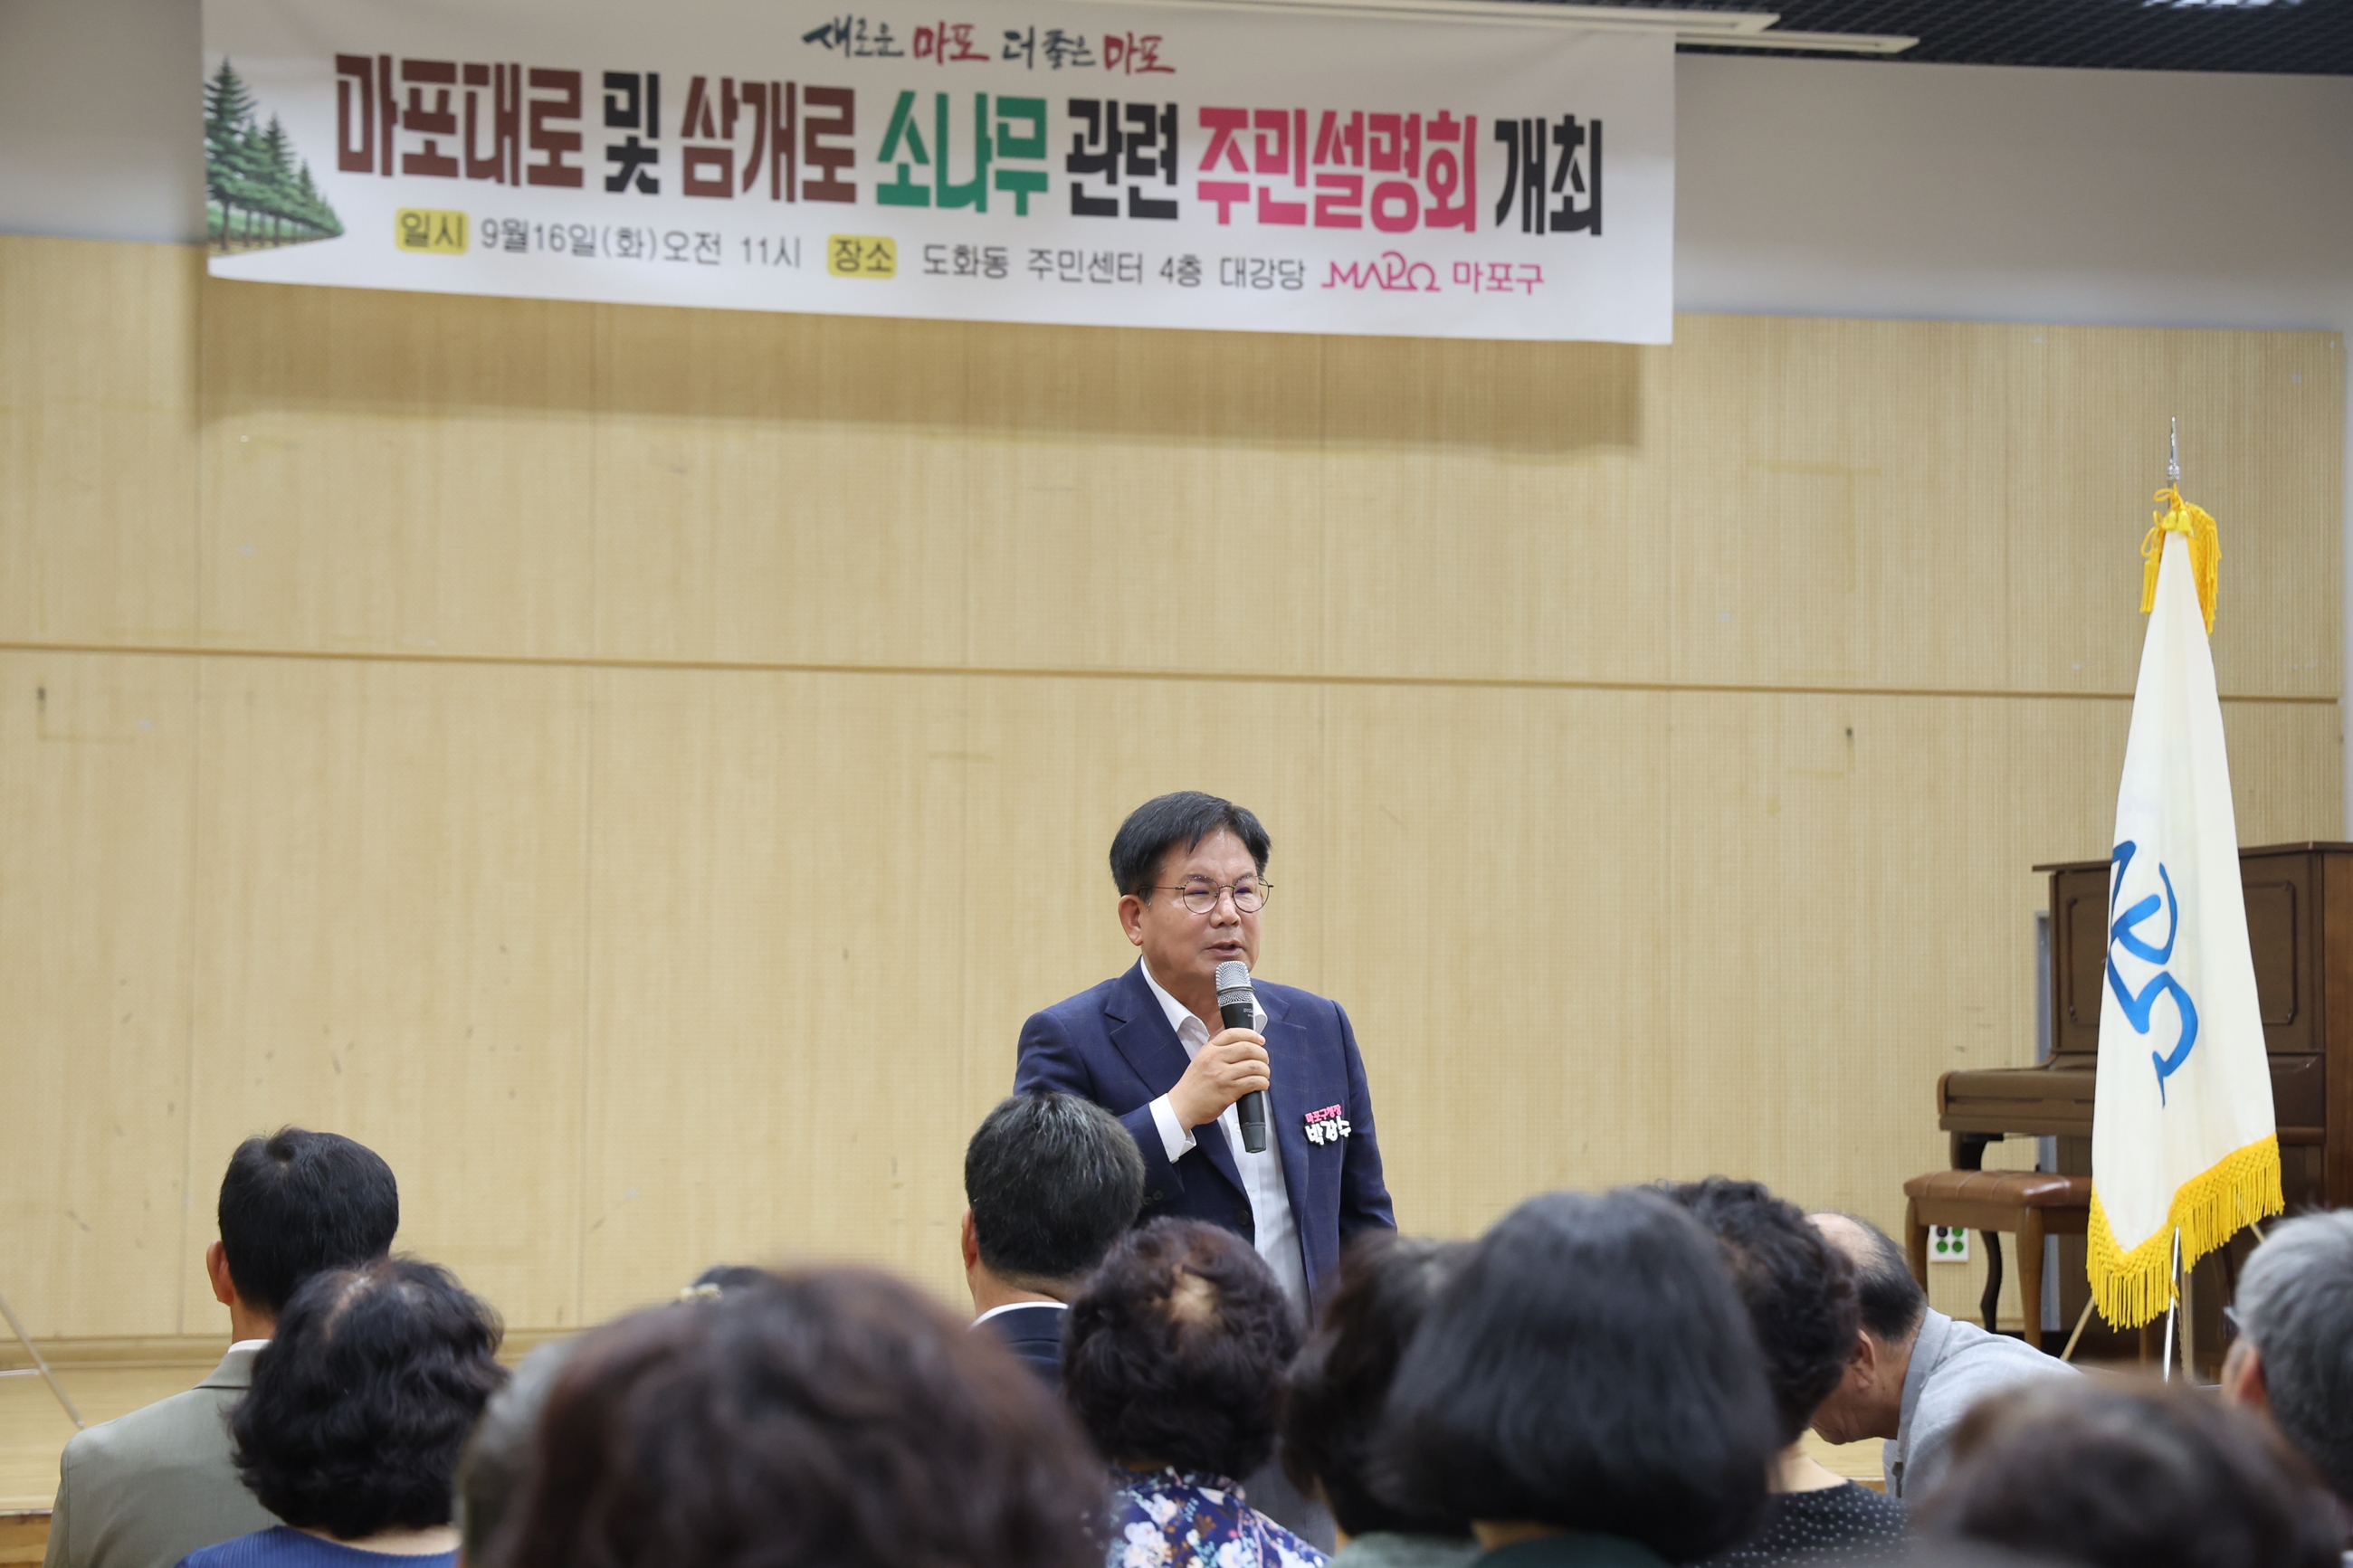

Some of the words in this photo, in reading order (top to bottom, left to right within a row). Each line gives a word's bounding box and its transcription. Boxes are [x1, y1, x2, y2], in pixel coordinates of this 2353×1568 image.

[801, 14, 904, 59] 새로운
[912, 20, 991, 66] 마포
[1001, 25, 1036, 71] 더
[1042, 28, 1097, 71] 좋은
[1102, 31, 1176, 76] 마포
[333, 52, 584, 189] 마포대로
[602, 70, 662, 195] 및
[680, 74, 857, 204] 삼개로
[875, 90, 1049, 217] 소나무
[1064, 97, 1179, 221] 관련
[1196, 106, 1479, 233] 주민설명회
[1493, 113, 1604, 236] 개최
[400, 212, 465, 249] 일시
[739, 236, 802, 269] 11시
[833, 237, 892, 273] 장소
[922, 242, 1010, 280] 도화동
[1026, 247, 1144, 285] 주민센터
[1158, 253, 1203, 288] 4층
[1219, 256, 1306, 291] 대강당
[1321, 250, 1442, 292] MAPO
[1453, 261, 1544, 295] 마포구
[1304, 1116, 1352, 1146] 박강수
